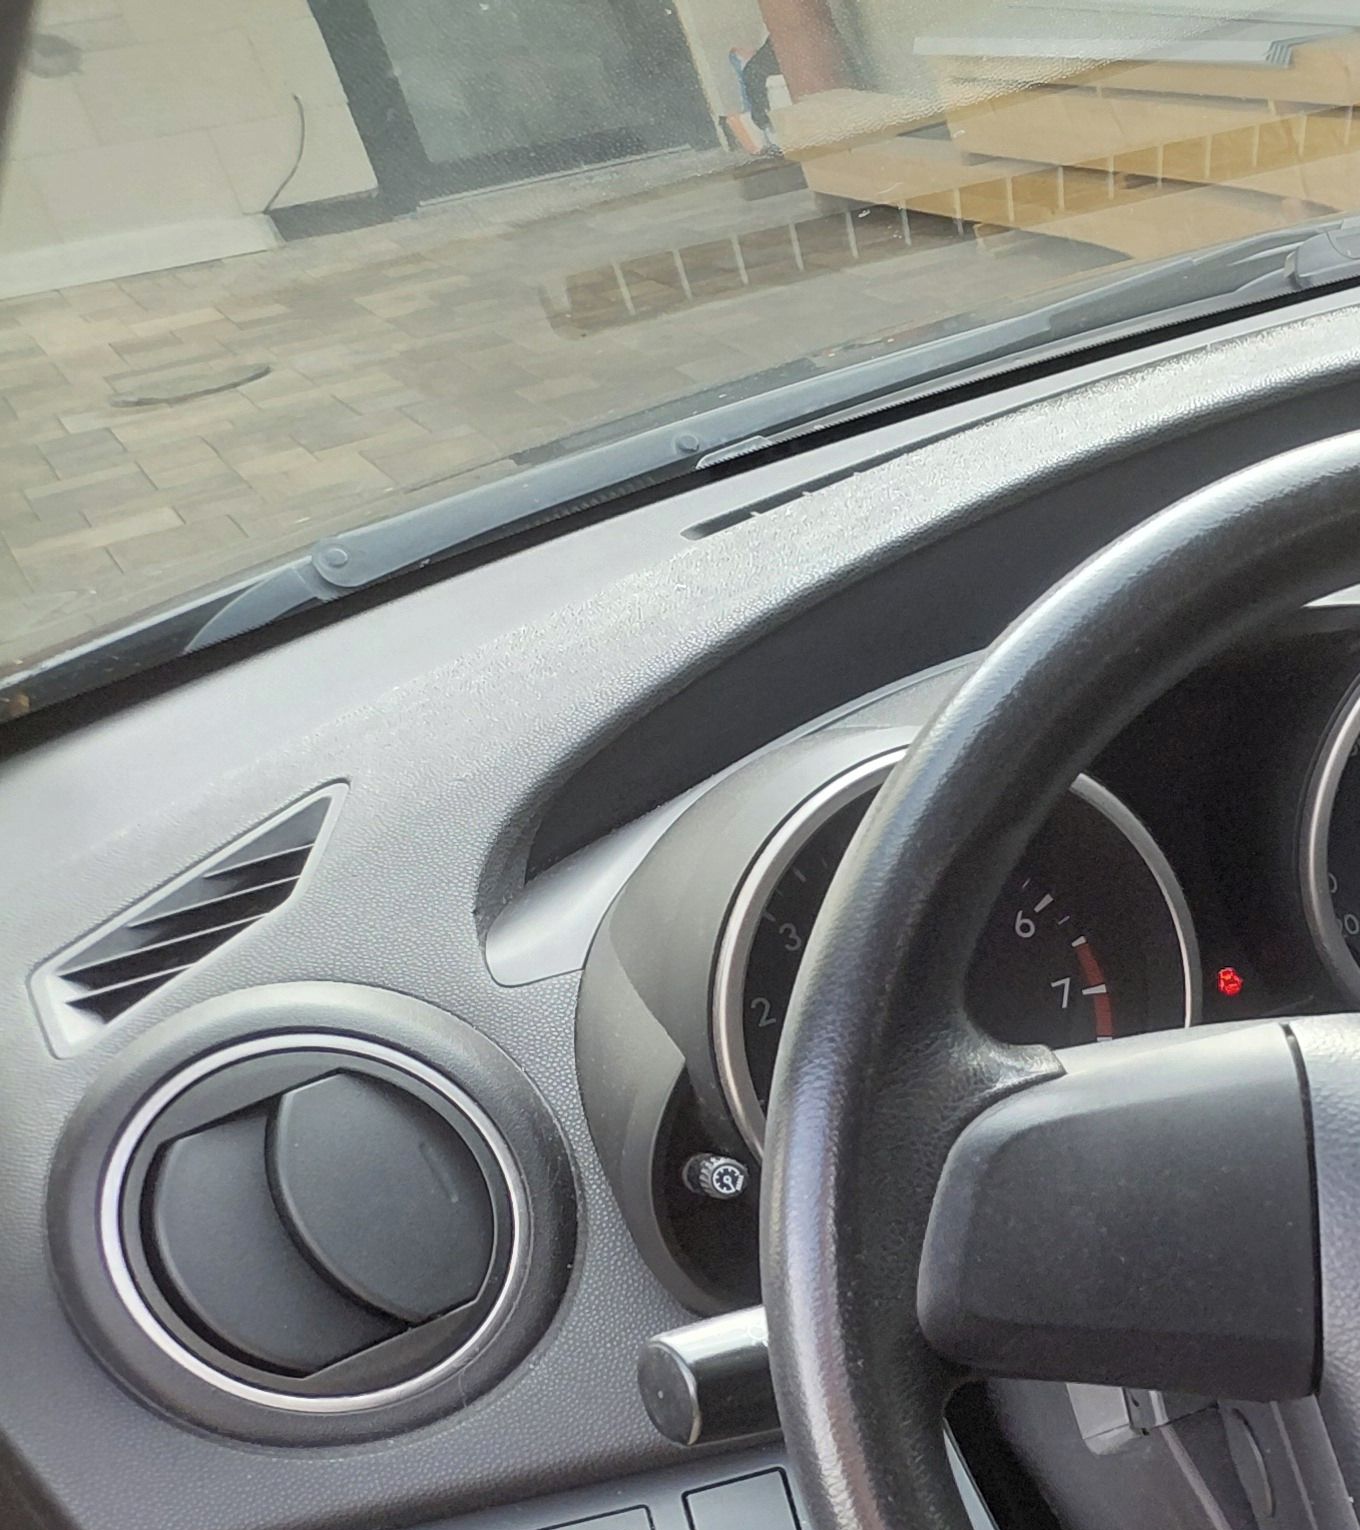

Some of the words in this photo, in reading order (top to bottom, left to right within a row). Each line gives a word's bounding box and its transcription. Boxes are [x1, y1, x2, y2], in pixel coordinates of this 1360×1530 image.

[779, 922, 802, 951] 3
[1014, 911, 1036, 939] 6
[1050, 977, 1072, 1008] 7
[751, 998, 776, 1028] 2
